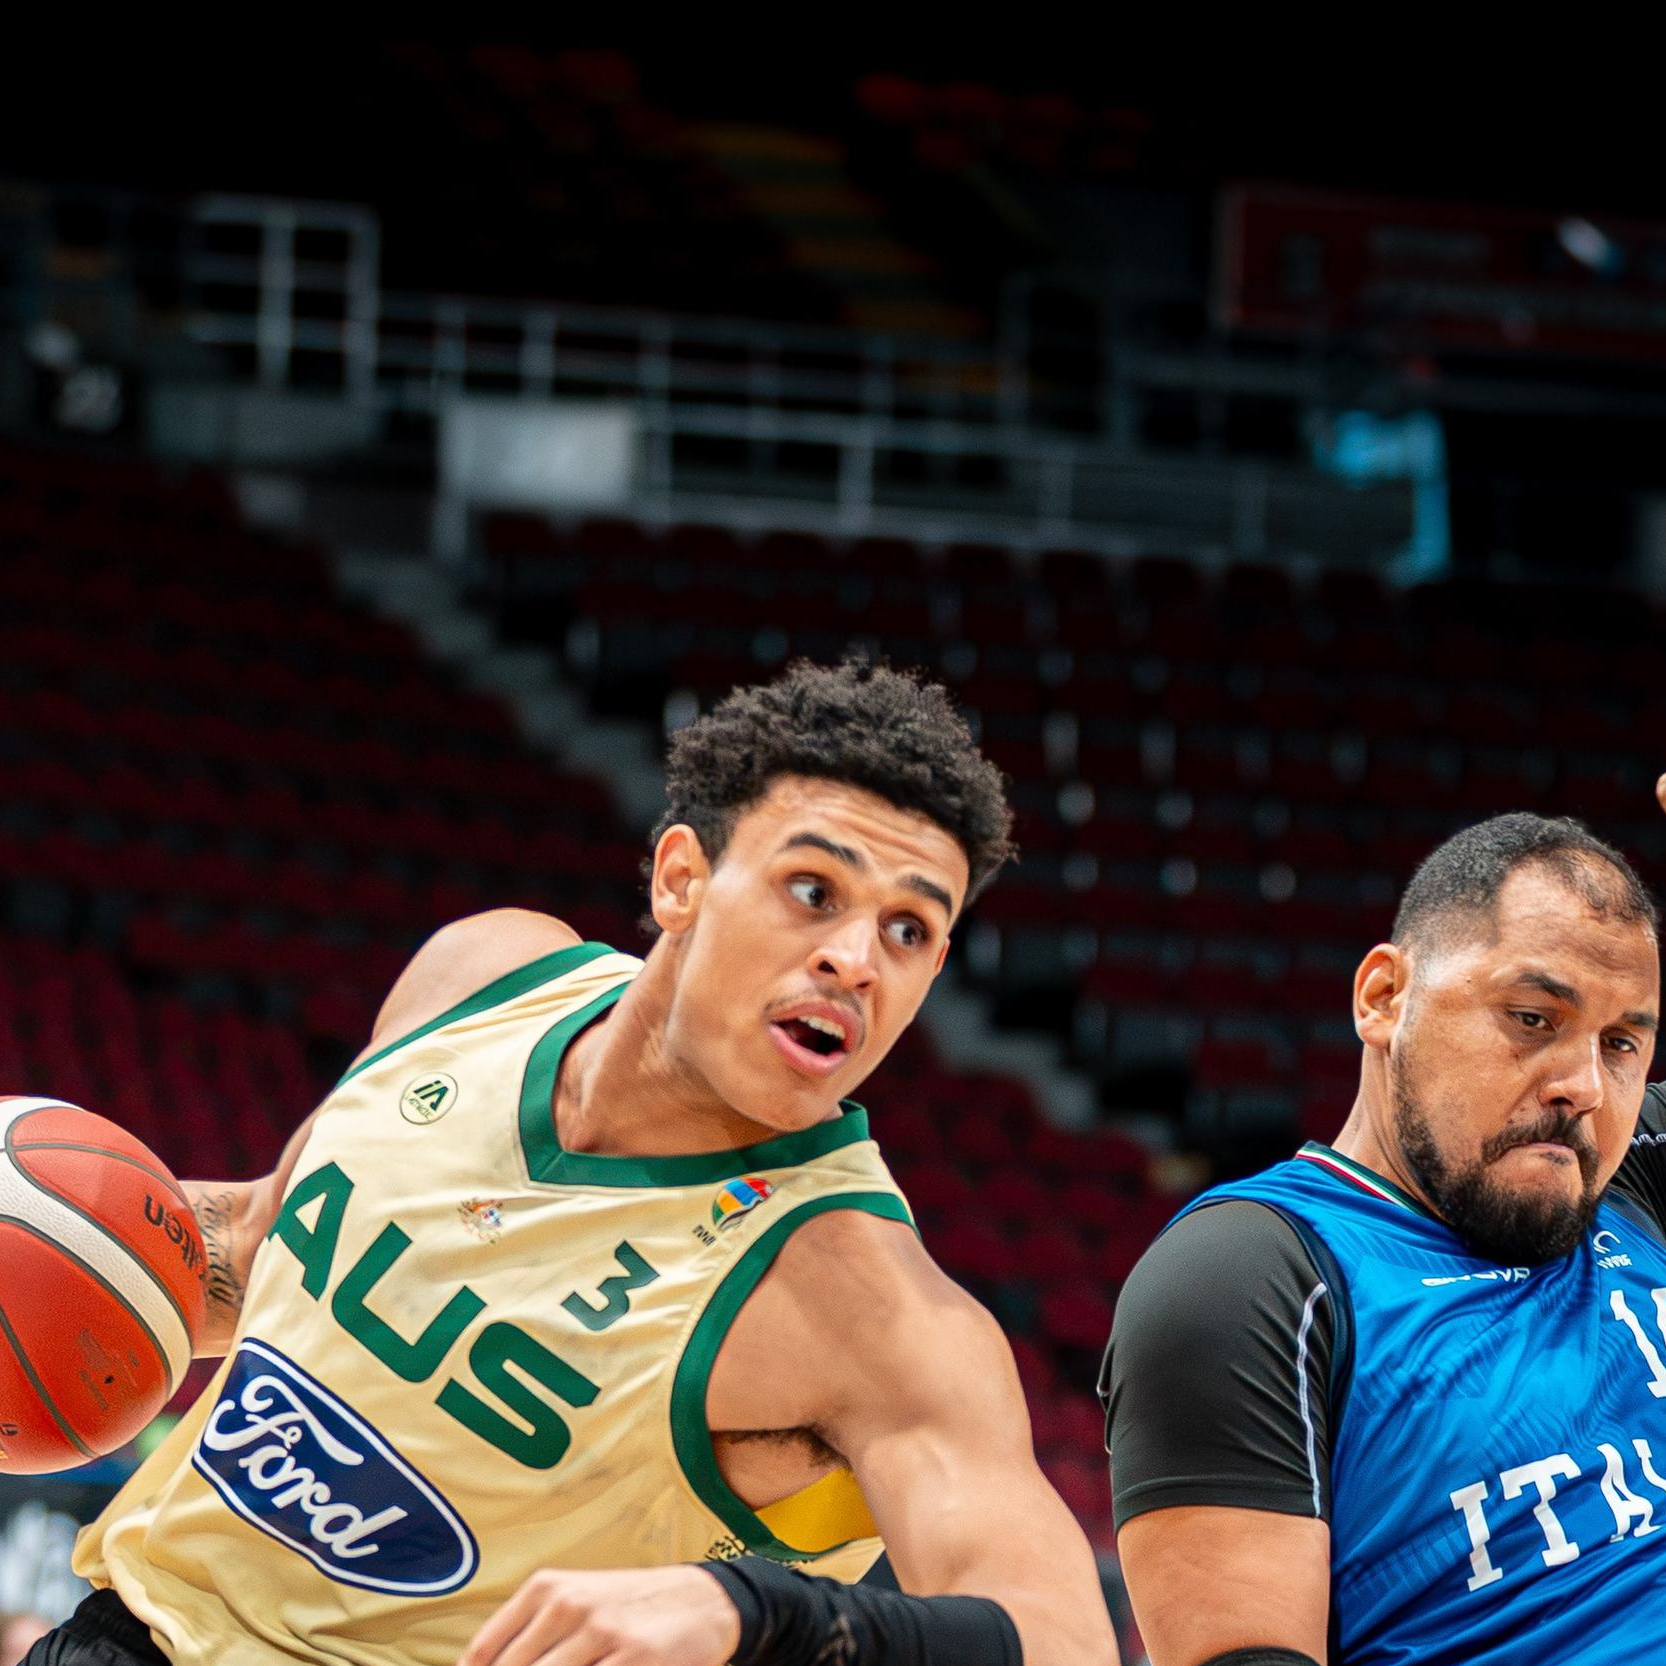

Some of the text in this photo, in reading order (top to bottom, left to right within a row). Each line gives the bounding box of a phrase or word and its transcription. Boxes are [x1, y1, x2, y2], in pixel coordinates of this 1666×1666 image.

[269, 1161, 602, 1470] AUS
[561, 1240, 660, 1331] 3
[203, 1375, 409, 1559] Ford
